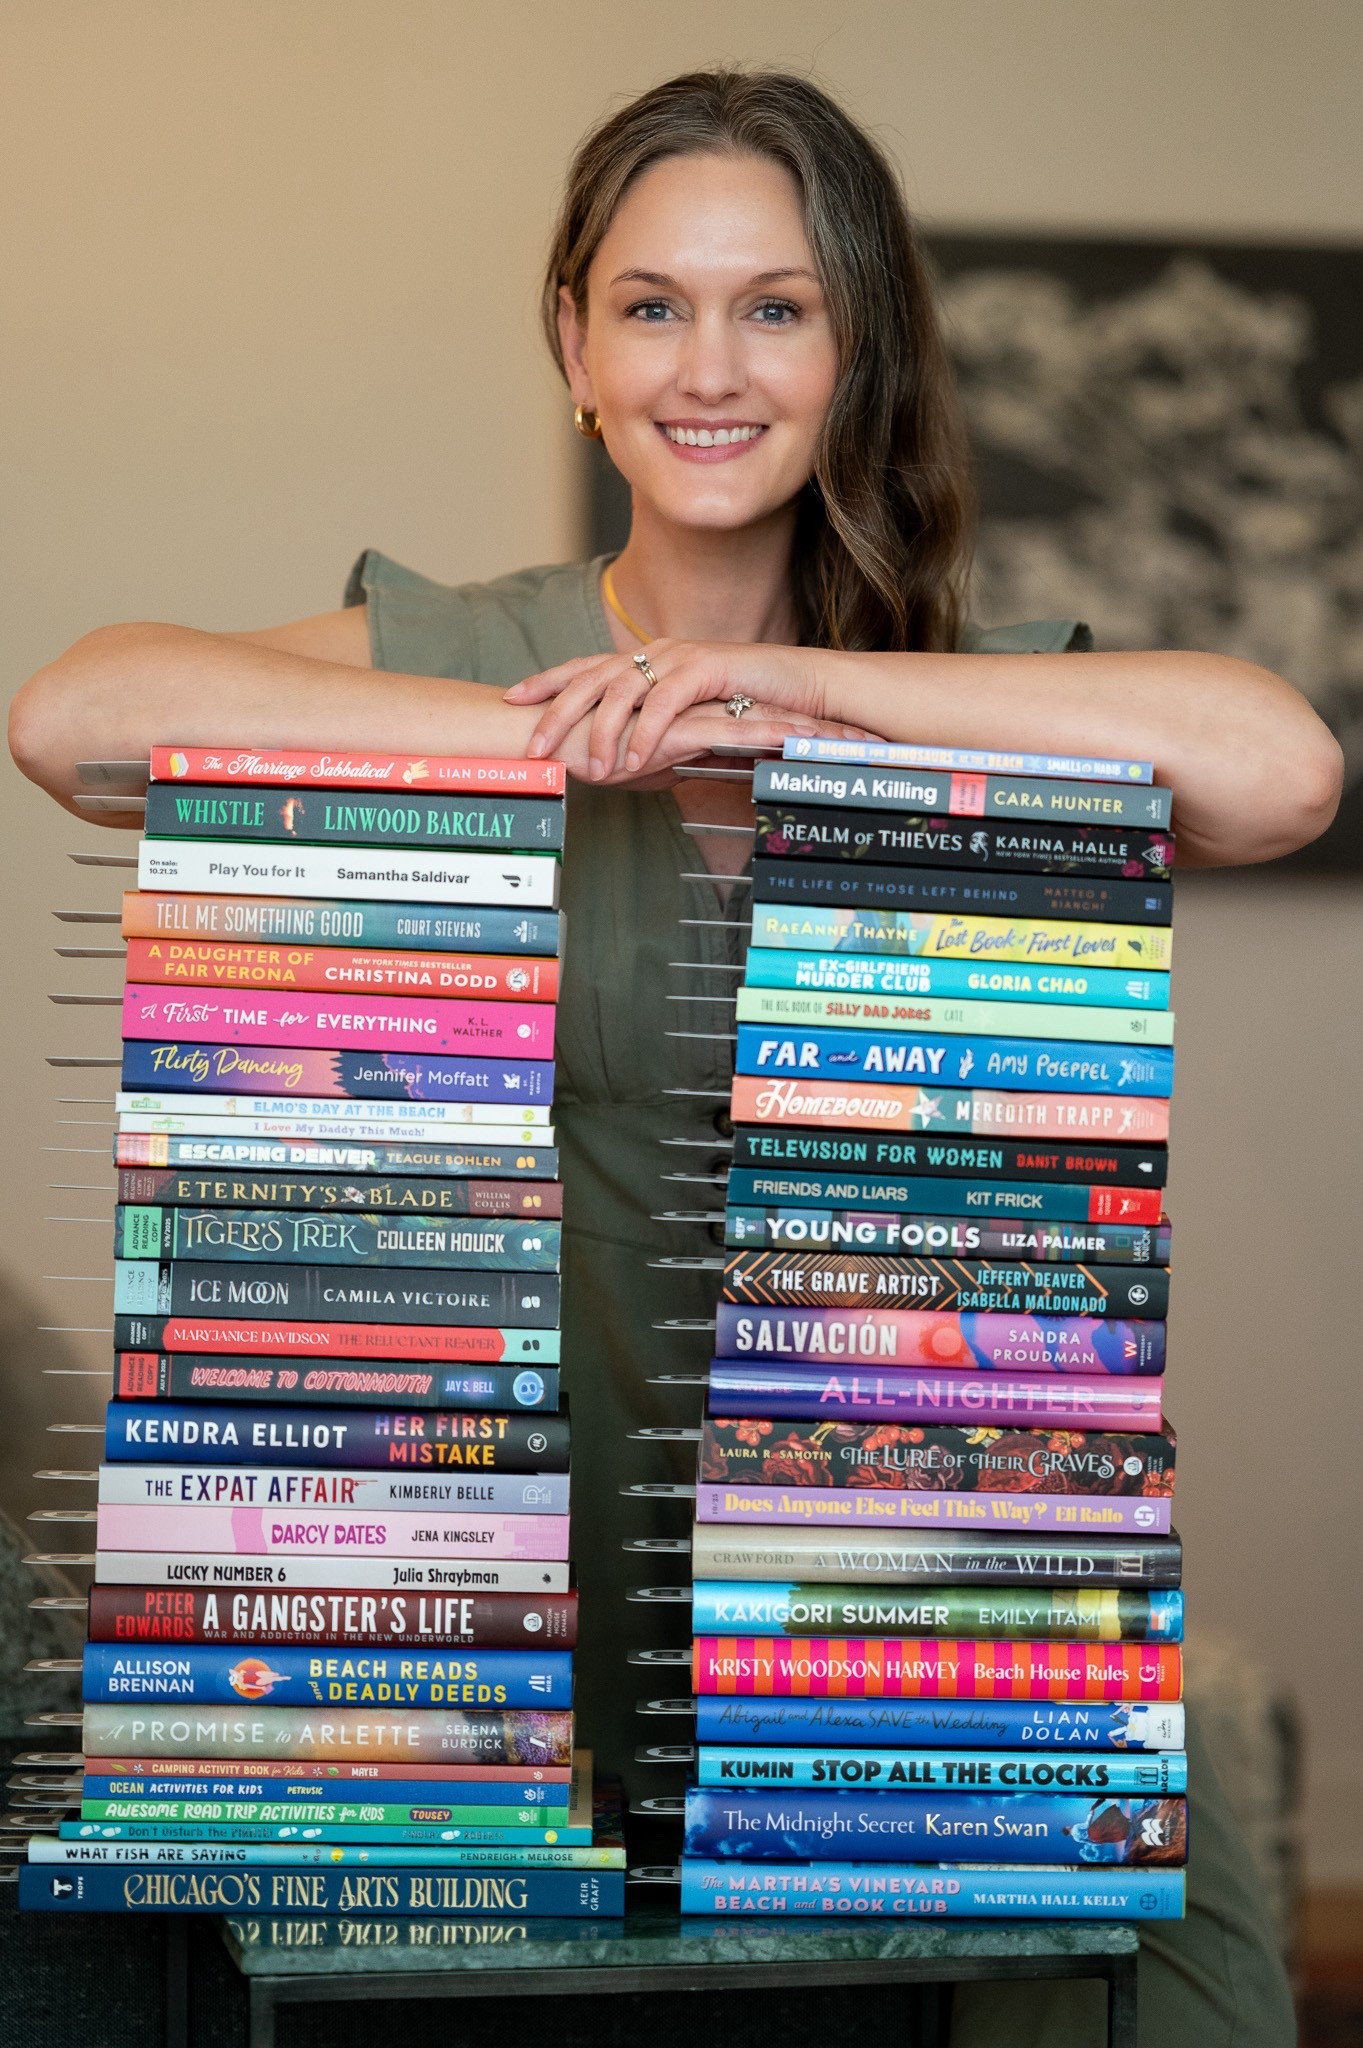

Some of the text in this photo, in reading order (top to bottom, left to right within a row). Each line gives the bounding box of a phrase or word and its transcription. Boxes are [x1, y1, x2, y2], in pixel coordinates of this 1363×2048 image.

[438, 767, 472, 780] LIAN
[477, 769, 528, 781] DOLAN
[769, 772, 847, 802] Making
[851, 777, 867, 795] A
[871, 779, 938, 804] Killing
[994, 791, 1045, 809] CARA
[1051, 794, 1123, 814] HUNTER
[176, 798, 264, 827] WHISTLE
[325, 806, 420, 834] LINWOOD
[426, 810, 515, 838] BARCLAY
[996, 835, 1128, 856] KARINA HALLE
[208, 862, 306, 878] Play You for It
[337, 868, 470, 885] Samantha Saldivar
[768, 877, 1018, 901] THE LIFE OF THOSE LEFT BEHIND
[397, 918, 481, 938] COURT STEVENS
[352, 956, 473, 971] NEW YORK TIMES BESTSELLER
[325, 967, 497, 988] CHRISTINA DODD
[968, 974, 1088, 995] GLORIA CHAO
[452, 1026, 503, 1038] WALTHER
[756, 1041, 947, 1076] FAR and AWAY
[353, 1065, 489, 1088] Jennifer Moffatt
[254, 1101, 446, 1119] ELMO'S DAY AT THE BEACH
[956, 1101, 1113, 1128] MEREDITH TRAPP
[179, 1144, 285, 1162] ESCAPING
[290, 1146, 376, 1166] DENVER
[387, 1152, 502, 1167] TEAGUE BOHLEN
[747, 1138, 1002, 1168] TELEVISION FOR WOMEN
[475, 1191, 511, 1200] WILLIAM
[475, 1200, 511, 1209] COLLIS
[966, 1191, 1043, 1209] KIT FRICK
[132, 1212, 140, 1249] ADVANCE
[141, 1214, 150, 1249] READING
[164, 1217, 172, 1248] 9/9/2025
[377, 1230, 505, 1254] COLLEEN HOUCK
[1001, 1233, 1106, 1251] LIZA PALMER
[1133, 1241, 1141, 1262] LAKE
[1142, 1230, 1150, 1263] UNION
[770, 1269, 939, 1297] THE GRAVE ARTIST
[976, 1270, 1085, 1290] JEFFERY DEAVER
[190, 1279, 222, 1303] ICE
[227, 1280, 289, 1305] MOON
[324, 1288, 490, 1307] CAMILA VICTOIRE
[173, 1328, 330, 1345] MARYJANICE DAVIDSON
[736, 1316, 898, 1356] SALVACIÓN
[1008, 1330, 1081, 1345] SANDRA
[993, 1348, 1095, 1364] PROUDMAN
[445, 1379, 494, 1393] JAY S. BELL
[819, 1376, 1095, 1413] ALL-NIGHTER
[125, 1419, 348, 1449] KENDRA ELLIOT
[374, 1415, 509, 1439] HER FIRST
[388, 1443, 496, 1465] MISTAKE
[720, 1447, 833, 1461] LAURA R. SAMOTIN
[389, 1484, 495, 1501] KIMBERLY BELLE
[1056, 1505, 1123, 1524] Eli Rallo
[411, 1529, 495, 1544] JENA KINGSLEY
[713, 1552, 794, 1565] CRAWFORD
[813, 1552, 1095, 1575] A WOMAN in the WILD
[167, 1565, 286, 1583] LUCKY NUMBER 6
[393, 1567, 499, 1586] Julia Shraybman
[145, 1593, 195, 1614] PETER
[715, 1602, 949, 1625] KAKIGORI SUMMER
[979, 1608, 1102, 1626] EMILY ITAMI
[115, 1615, 195, 1638] EDWARDS
[113, 1660, 191, 1676] ALLISON
[974, 1663, 1129, 1682] Beach House Rules
[108, 1675, 195, 1693] BRENNAN
[1033, 1710, 1089, 1724] LIAN
[446, 1724, 499, 1737] SERENA
[1021, 1725, 1099, 1741] DOLAN
[441, 1737, 503, 1750] BURDICK
[352, 1766, 378, 1777] MAYER
[720, 1760, 794, 1779] KUMIN
[1160, 1759, 1168, 1793] ARCADE
[109, 1781, 263, 1796] OCEAN ACTIVITIES FOR KIDS
[413, 1810, 450, 1820] TOUSEY
[925, 1815, 1049, 1838] Karen Swan
[460, 1852, 574, 1862] PENDREIGH MELROSE
[124, 1873, 528, 1910] CHICAGO'S FINE ARTS BUILDING
[580, 1881, 588, 1905] KEIR
[590, 1877, 599, 1910] GRAFF
[973, 1893, 1129, 1908] MARTHA HALL KELLY
